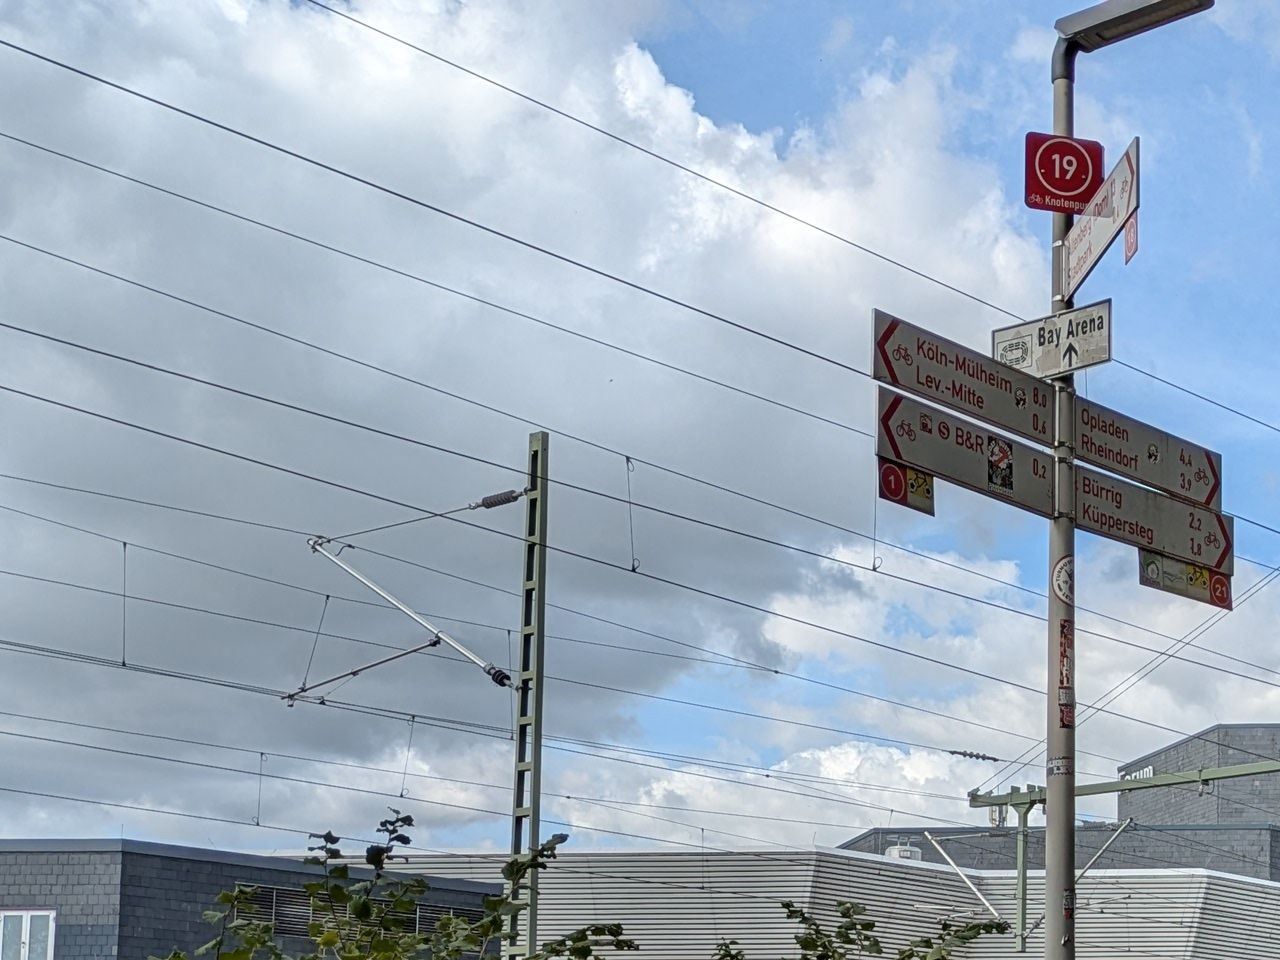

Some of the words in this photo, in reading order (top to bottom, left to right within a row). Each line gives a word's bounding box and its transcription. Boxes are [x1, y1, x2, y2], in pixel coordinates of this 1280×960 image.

[1051, 153, 1078, 180] 19
[1037, 325, 1062, 349] Bay
[1066, 315, 1104, 340] Arena
[916, 337, 1013, 395] Köln-Mülheim
[916, 365, 985, 410] Lev.-Mitte
[955, 427, 985, 455] B&R
[1081, 408, 1129, 443] Opladen
[1081, 433, 1139, 471] Rheindorf
[1180, 473, 1192, 492] 3,9
[888, 475, 895, 489] 1
[1082, 476, 1123, 509] Bürrig
[1082, 502, 1154, 545] Küppersteg
[1215, 584, 1227, 598] 21
